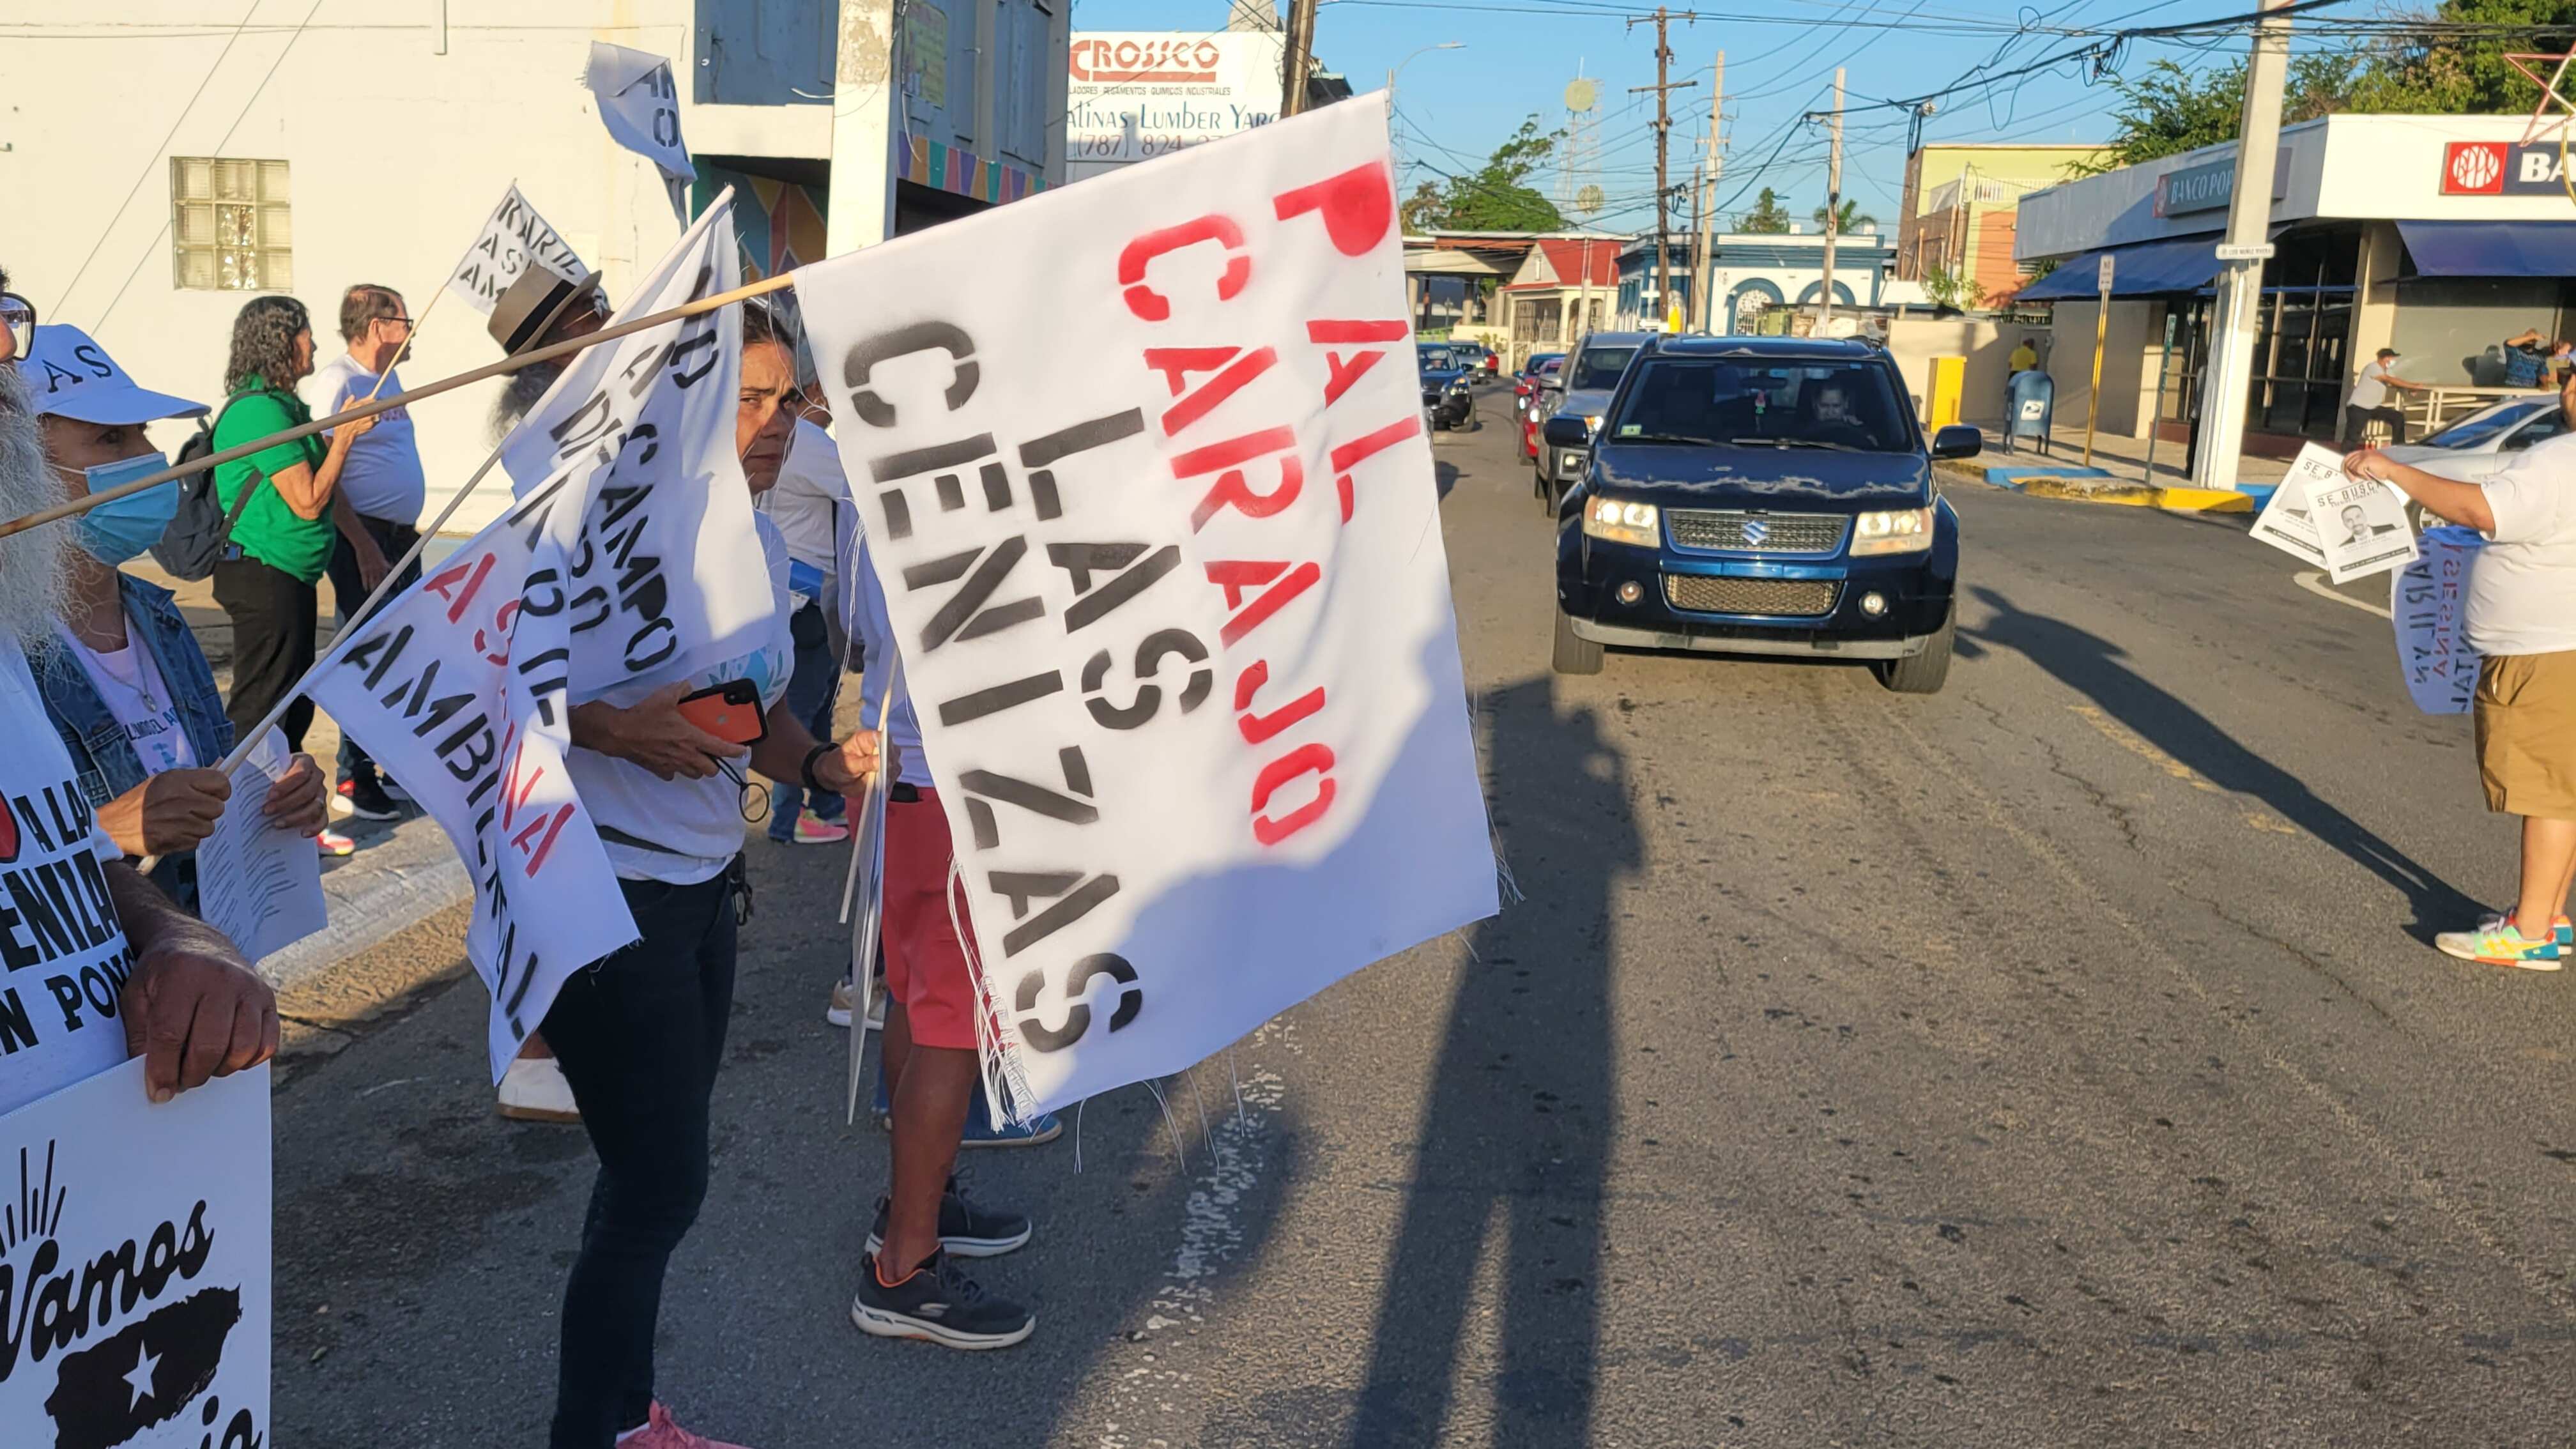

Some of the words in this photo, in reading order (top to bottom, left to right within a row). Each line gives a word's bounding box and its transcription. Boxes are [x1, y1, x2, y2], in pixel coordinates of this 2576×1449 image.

[1070, 40, 1220, 81] CROSSCO
[1103, 86, 1146, 95] PEGAMENTOS
[1151, 87, 1183, 96] QUIMICOS
[1186, 87, 1231, 95] INDUSTRIALES
[1077, 132, 1129, 158] (787)
[2171, 175, 2207, 204] BANCO
[1273, 161, 1420, 525] PAL
[2303, 461, 2320, 475] SE
[2317, 496, 2335, 507] SE
[1118, 213, 1340, 848] CARAJO
[1017, 407, 1214, 732] LAS
[843, 319, 1144, 1054] CENIZAS
[12, 795, 57, 853] A
[42, 778, 93, 845] LA
